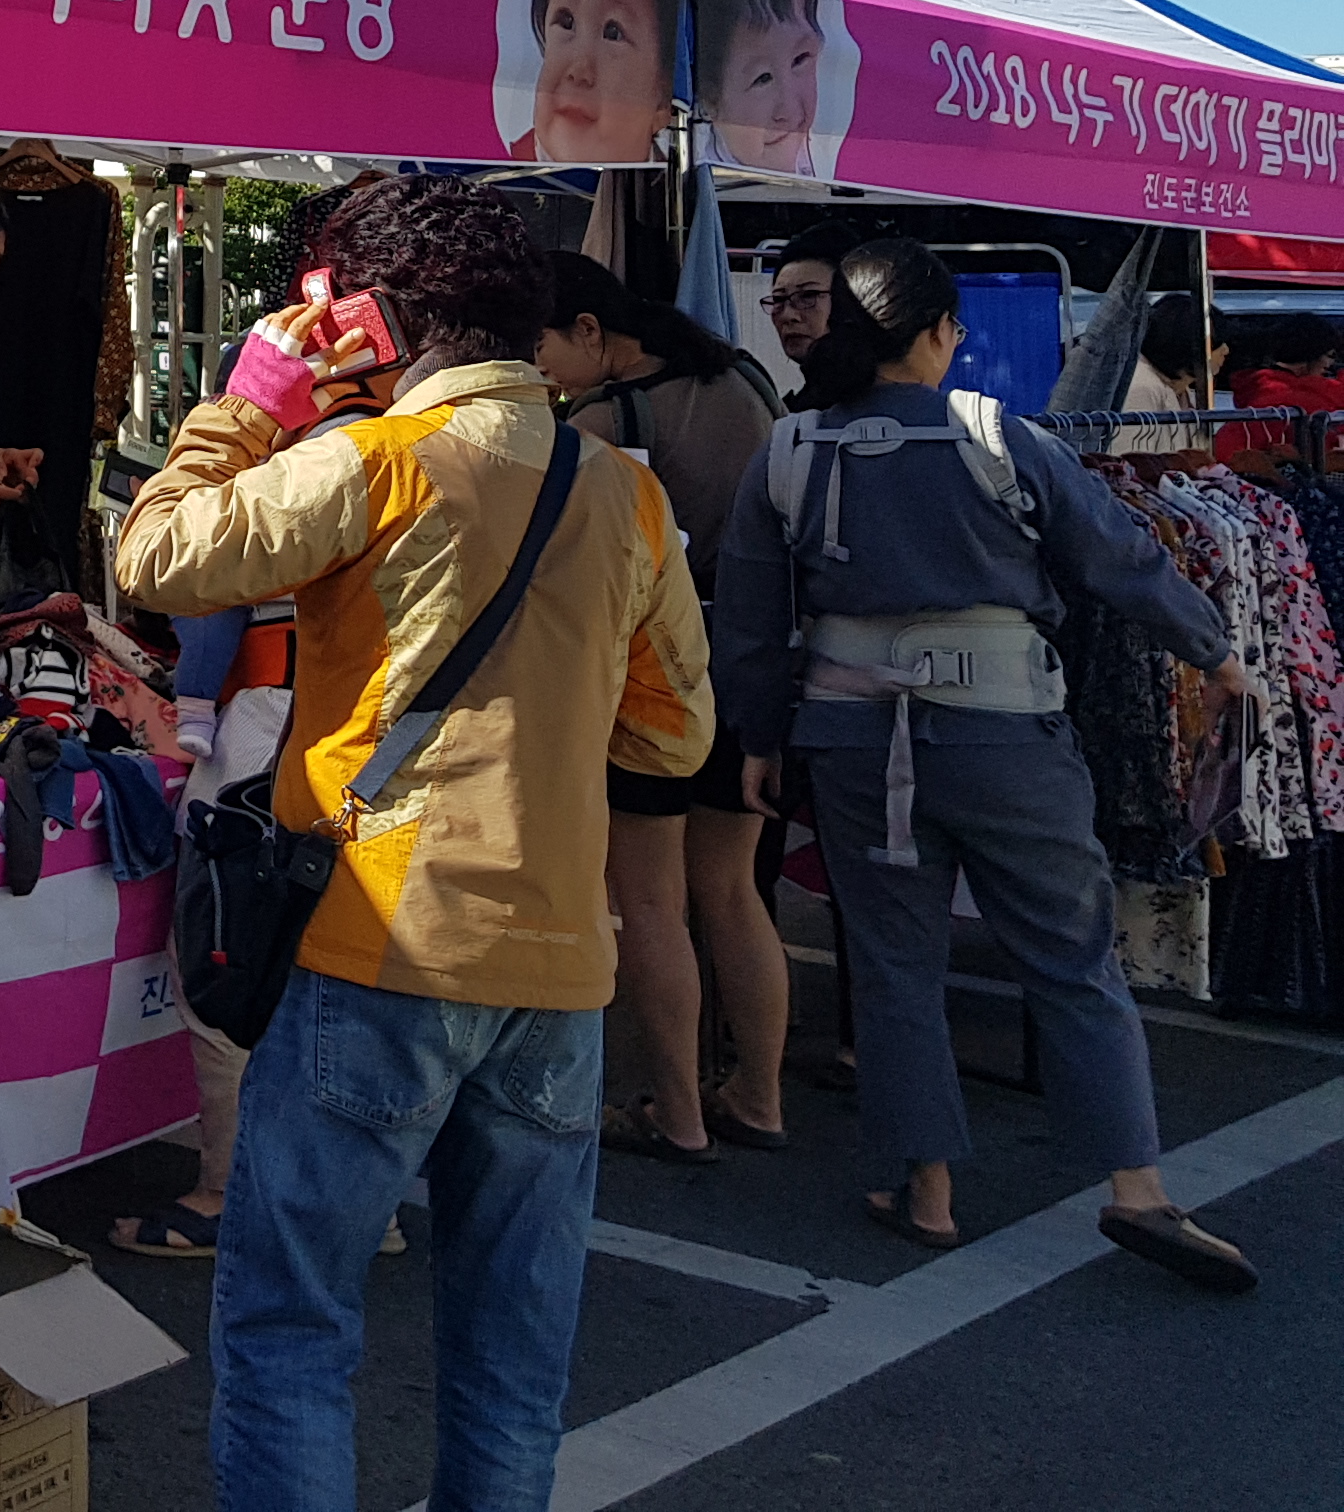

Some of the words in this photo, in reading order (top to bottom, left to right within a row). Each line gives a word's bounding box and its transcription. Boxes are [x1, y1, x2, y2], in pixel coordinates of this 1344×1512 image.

[930, 39, 1037, 130] 2018
[1040, 60, 1148, 155] 나누기
[1154, 83, 1249, 170] 더하기
[1255, 99, 1344, 183] 플리마
[1142, 172, 1252, 218] 진도군보건소
